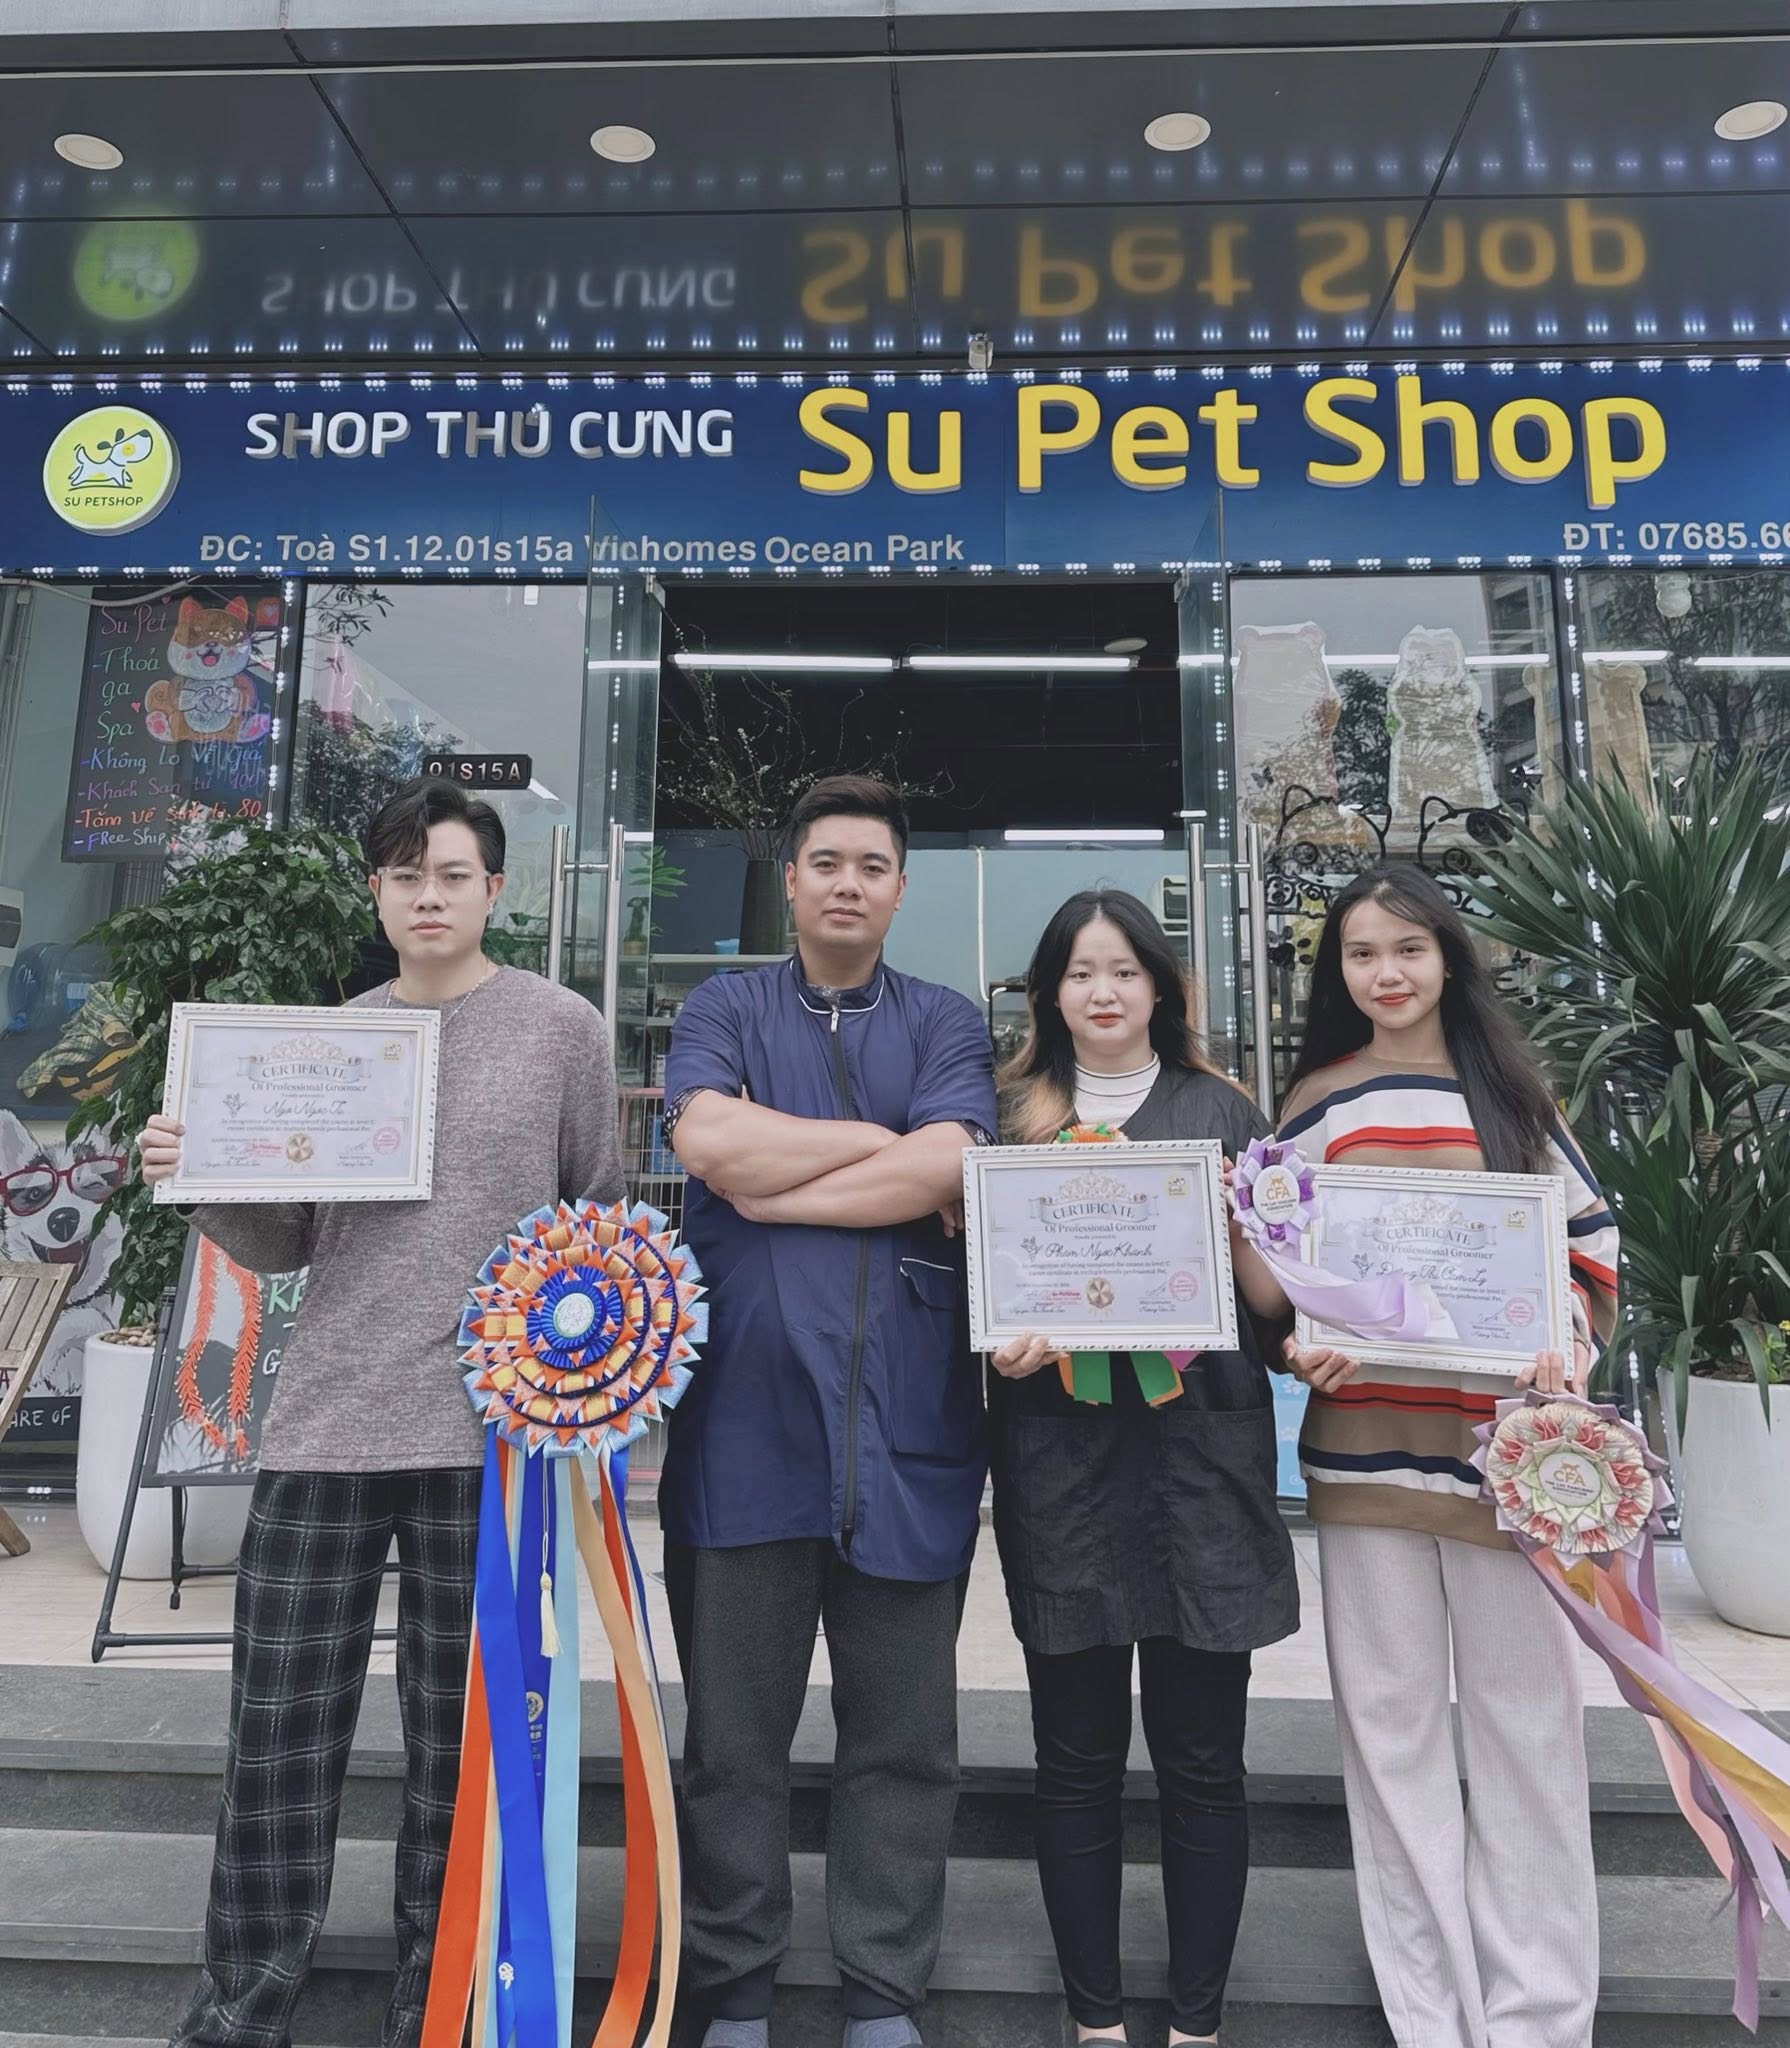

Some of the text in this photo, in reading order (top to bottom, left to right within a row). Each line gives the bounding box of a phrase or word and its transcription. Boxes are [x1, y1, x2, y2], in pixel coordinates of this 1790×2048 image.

[245, 410, 411, 459] SHOP
[569, 408, 734, 459] CƯNG
[798, 375, 1667, 511] Su Pet Shop
[64, 495, 144, 507] SU PETSHOP
[1562, 522, 1626, 551] ĐT:
[200, 534, 263, 562] ĐC:
[276, 532, 336, 562] Toà
[347, 533, 574, 562] S1.12.01s15a
[763, 536, 873, 564] Ocean
[886, 534, 965, 562] Park
[101, 603, 167, 643] Su Pet
[101, 680, 132, 706] ga
[97, 710, 134, 745] Spa
[429, 761, 522, 781] 01S15A
[236, 798, 262, 818] 80
[262, 1062, 347, 1080] CERTIFICATE
[266, 1081, 324, 1092] Professional
[325, 1082, 368, 1093] Groomer
[1265, 1185, 1290, 1201] CFA
[1052, 1202, 1135, 1220] CERTIFICATE
[1044, 1221, 1157, 1234] Of Professional Groomer
[1386, 1225, 1471, 1247] CERTIFICATE
[1391, 1243, 1449, 1258] Professional
[1450, 1248, 1495, 1260] Groomer
[51, 1405, 72, 1426] OF
[1552, 1468, 1587, 1487] CFA
